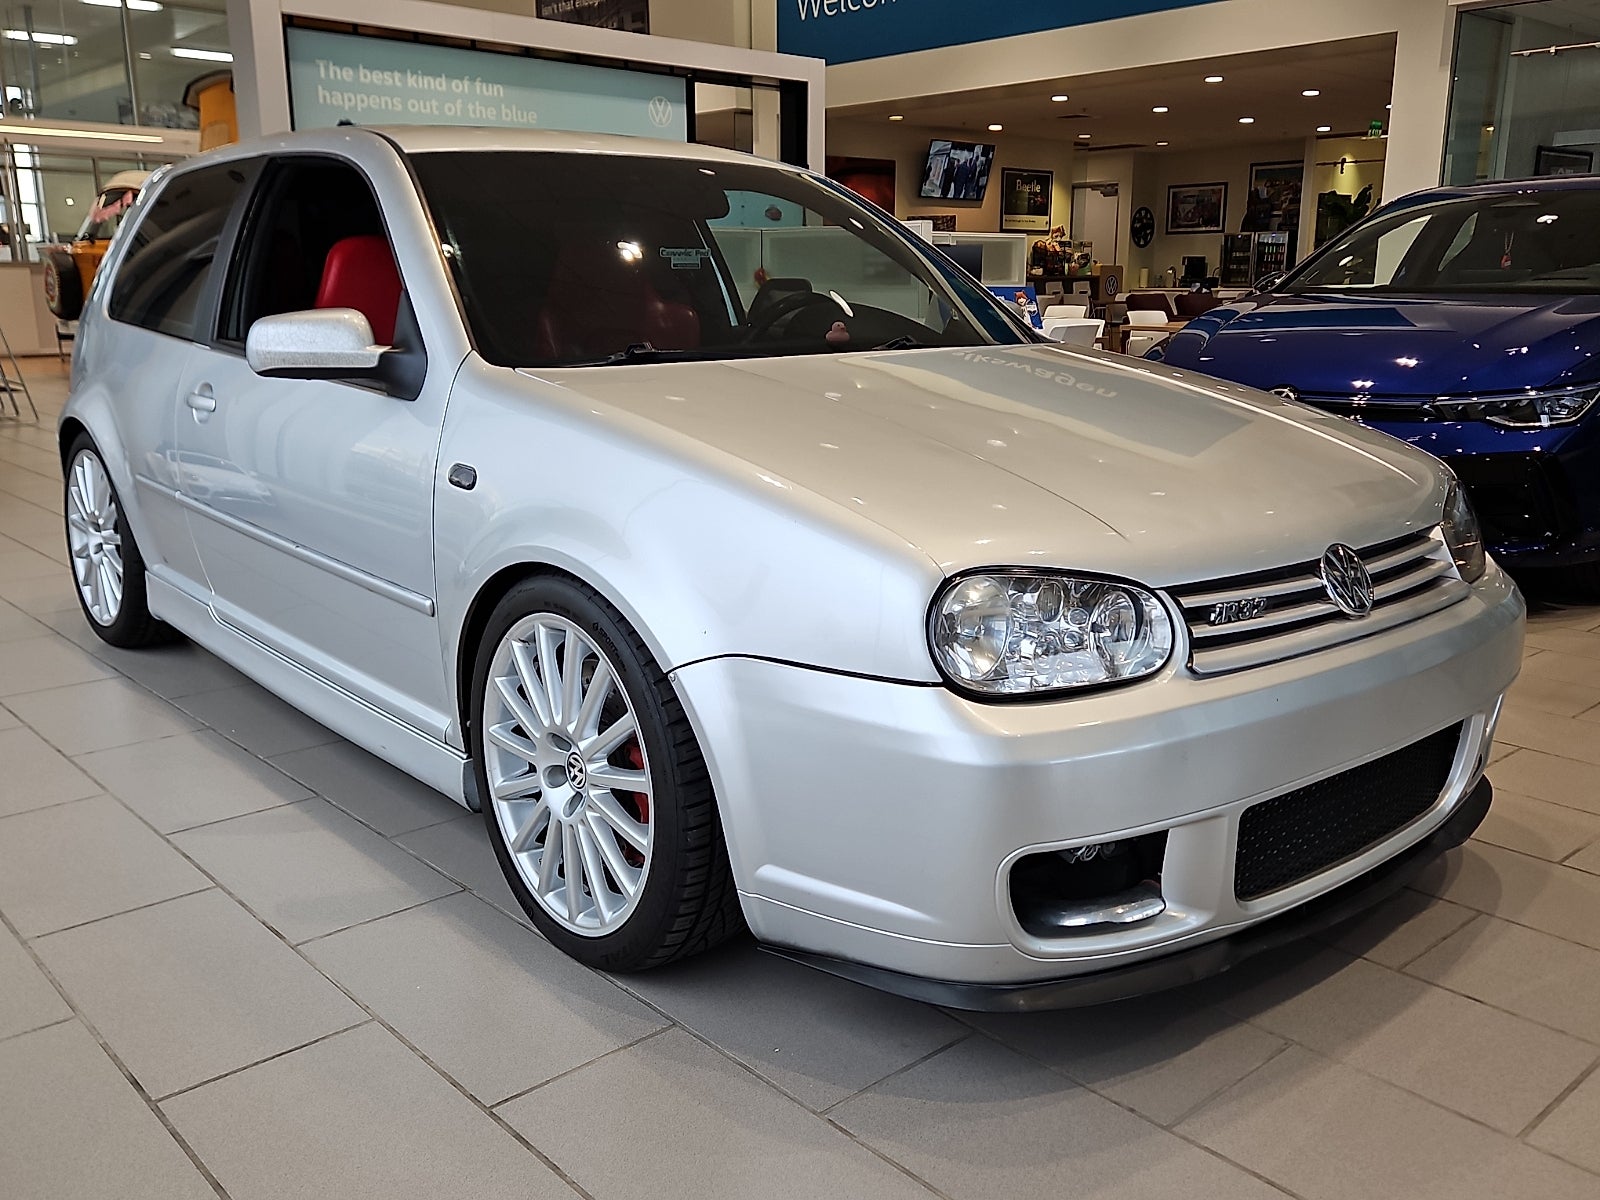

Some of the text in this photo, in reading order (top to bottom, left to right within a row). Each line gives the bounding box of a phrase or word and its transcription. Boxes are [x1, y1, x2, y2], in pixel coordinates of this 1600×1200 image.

[315, 59, 504, 97] The best kind of fun
[318, 86, 538, 124] happens out of the blue
[1016, 179, 1041, 193] Beetle
